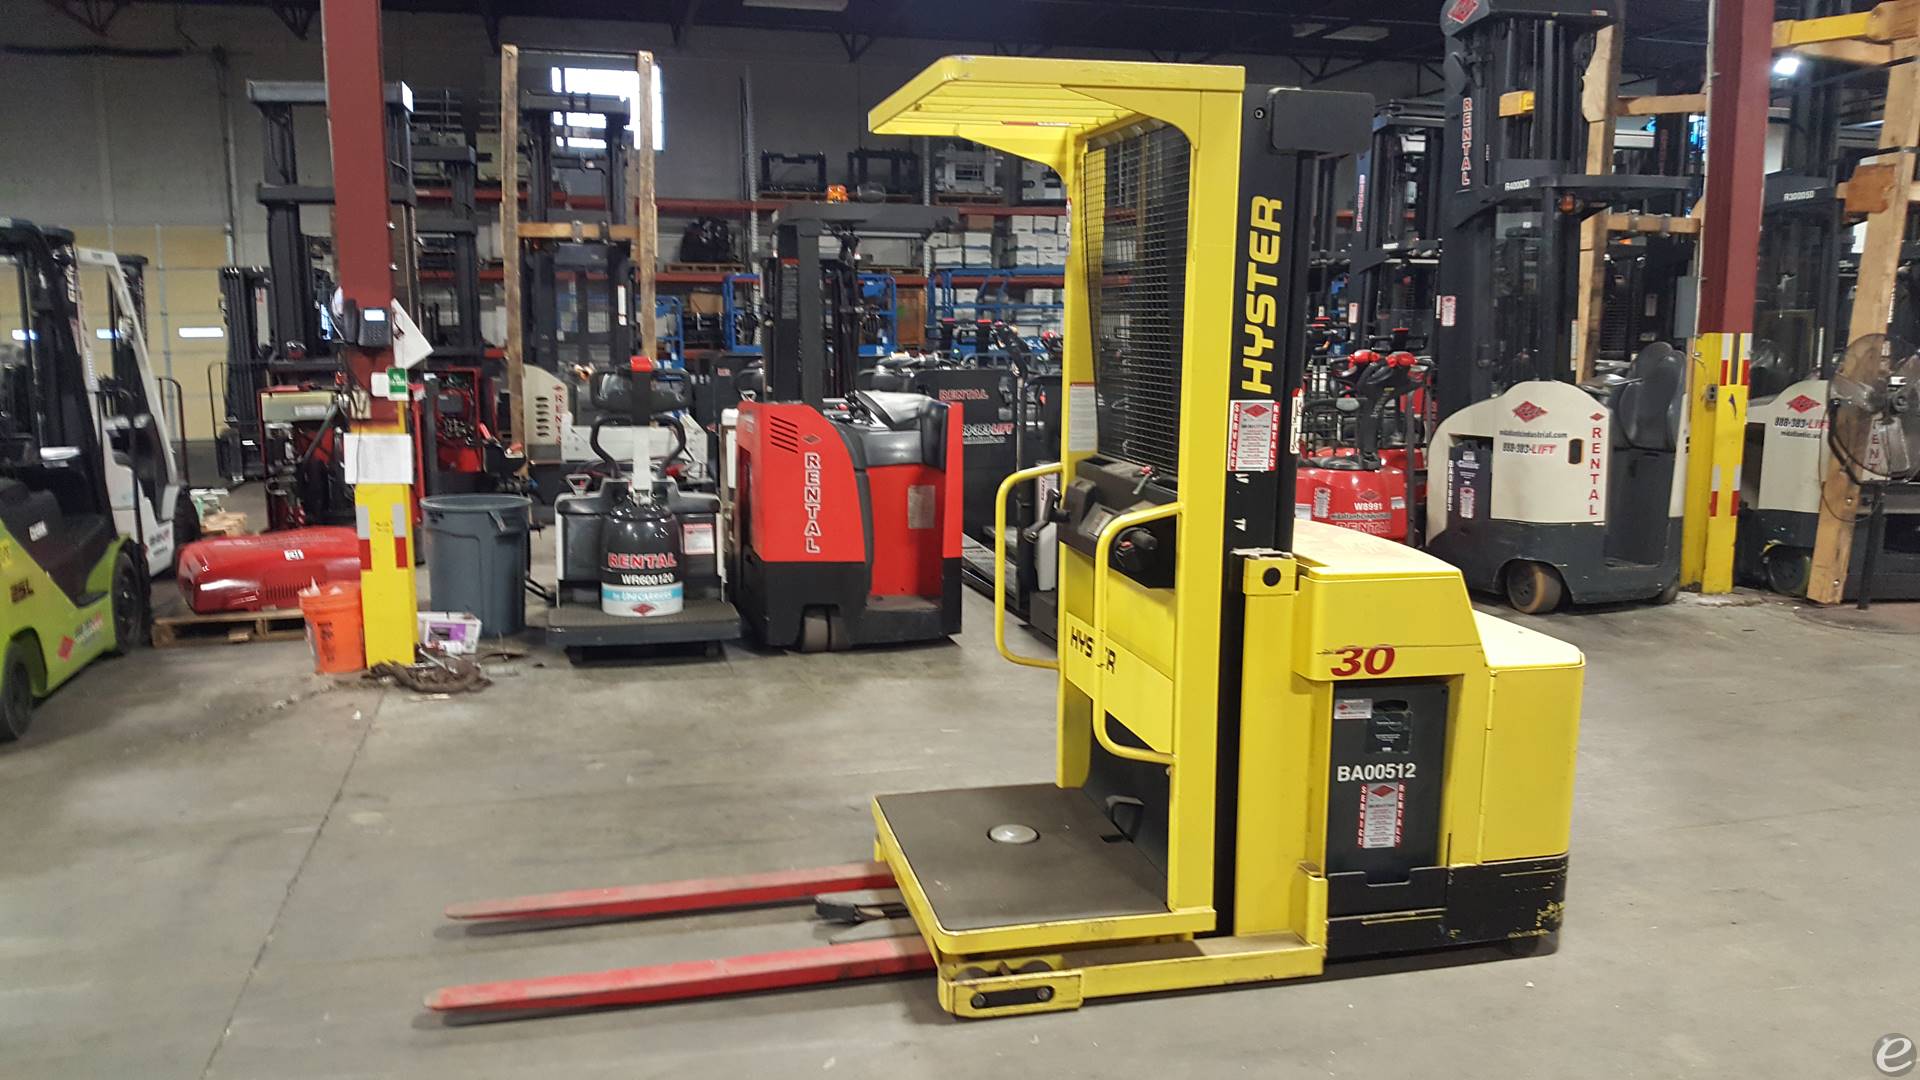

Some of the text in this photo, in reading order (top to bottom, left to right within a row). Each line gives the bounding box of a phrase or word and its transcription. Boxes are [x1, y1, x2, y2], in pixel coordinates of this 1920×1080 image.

[1461, 97, 1473, 186] RENTAL
[1241, 195, 1283, 395] HYSTER
[939, 388, 990, 400] RENTAL
[1588, 426, 1602, 516] RENTAL
[804, 451, 821, 553] RENTAL
[608, 552, 677, 570] RENTAL
[1070, 625, 1117, 675] HYSR
[1331, 646, 1395, 677] 30
[1336, 762, 1417, 782] BA00512
